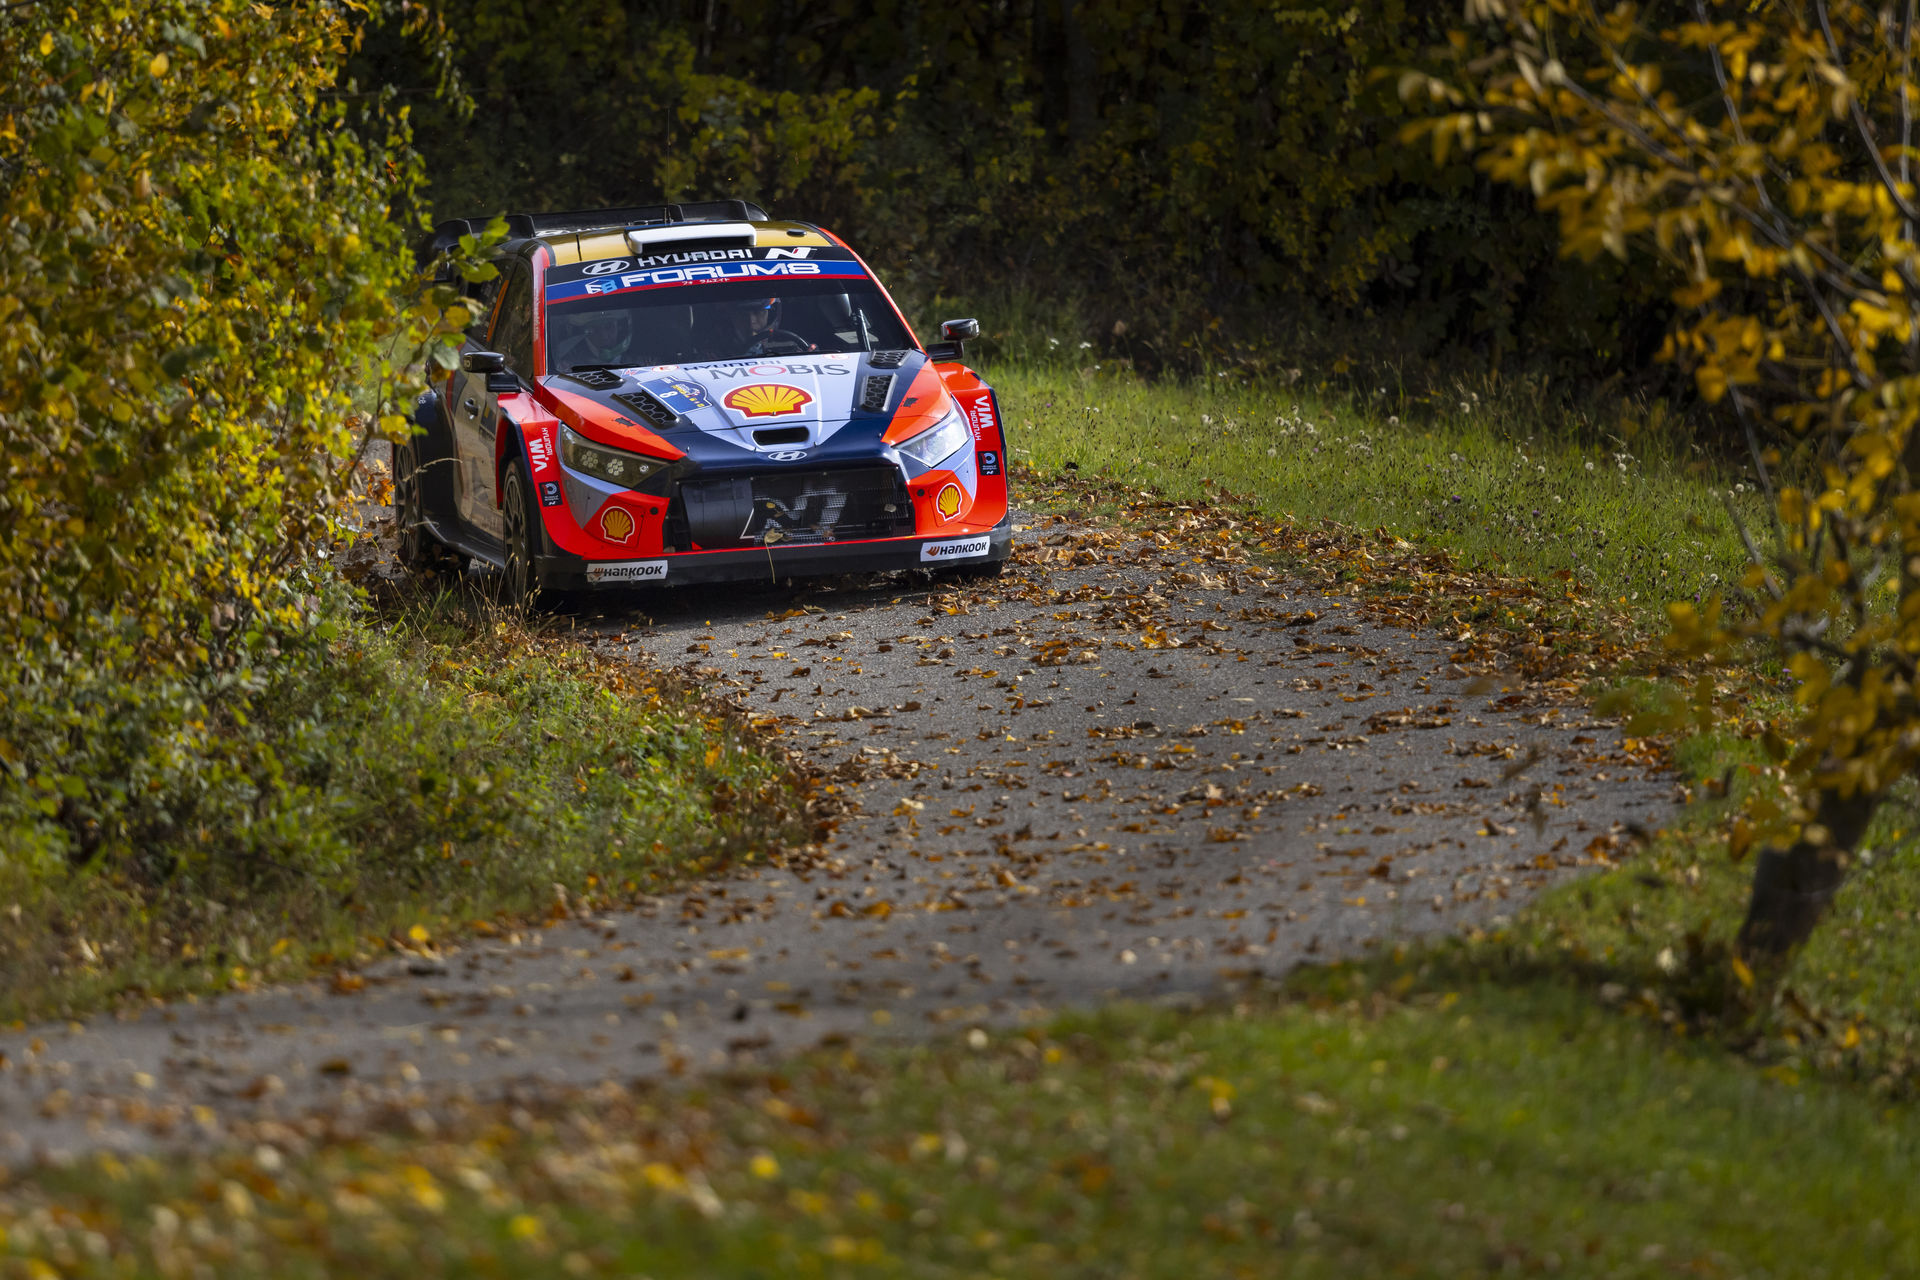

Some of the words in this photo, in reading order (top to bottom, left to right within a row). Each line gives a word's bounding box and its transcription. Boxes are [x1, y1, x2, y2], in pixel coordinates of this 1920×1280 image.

[637, 249, 753, 267] HYUNDAI
[620, 263, 821, 288] FORUM8
[708, 364, 850, 380] MOBIS
[659, 390, 679, 399] 8
[970, 410, 982, 441] HYUNDAI
[541, 427, 553, 456] HYUNDAI
